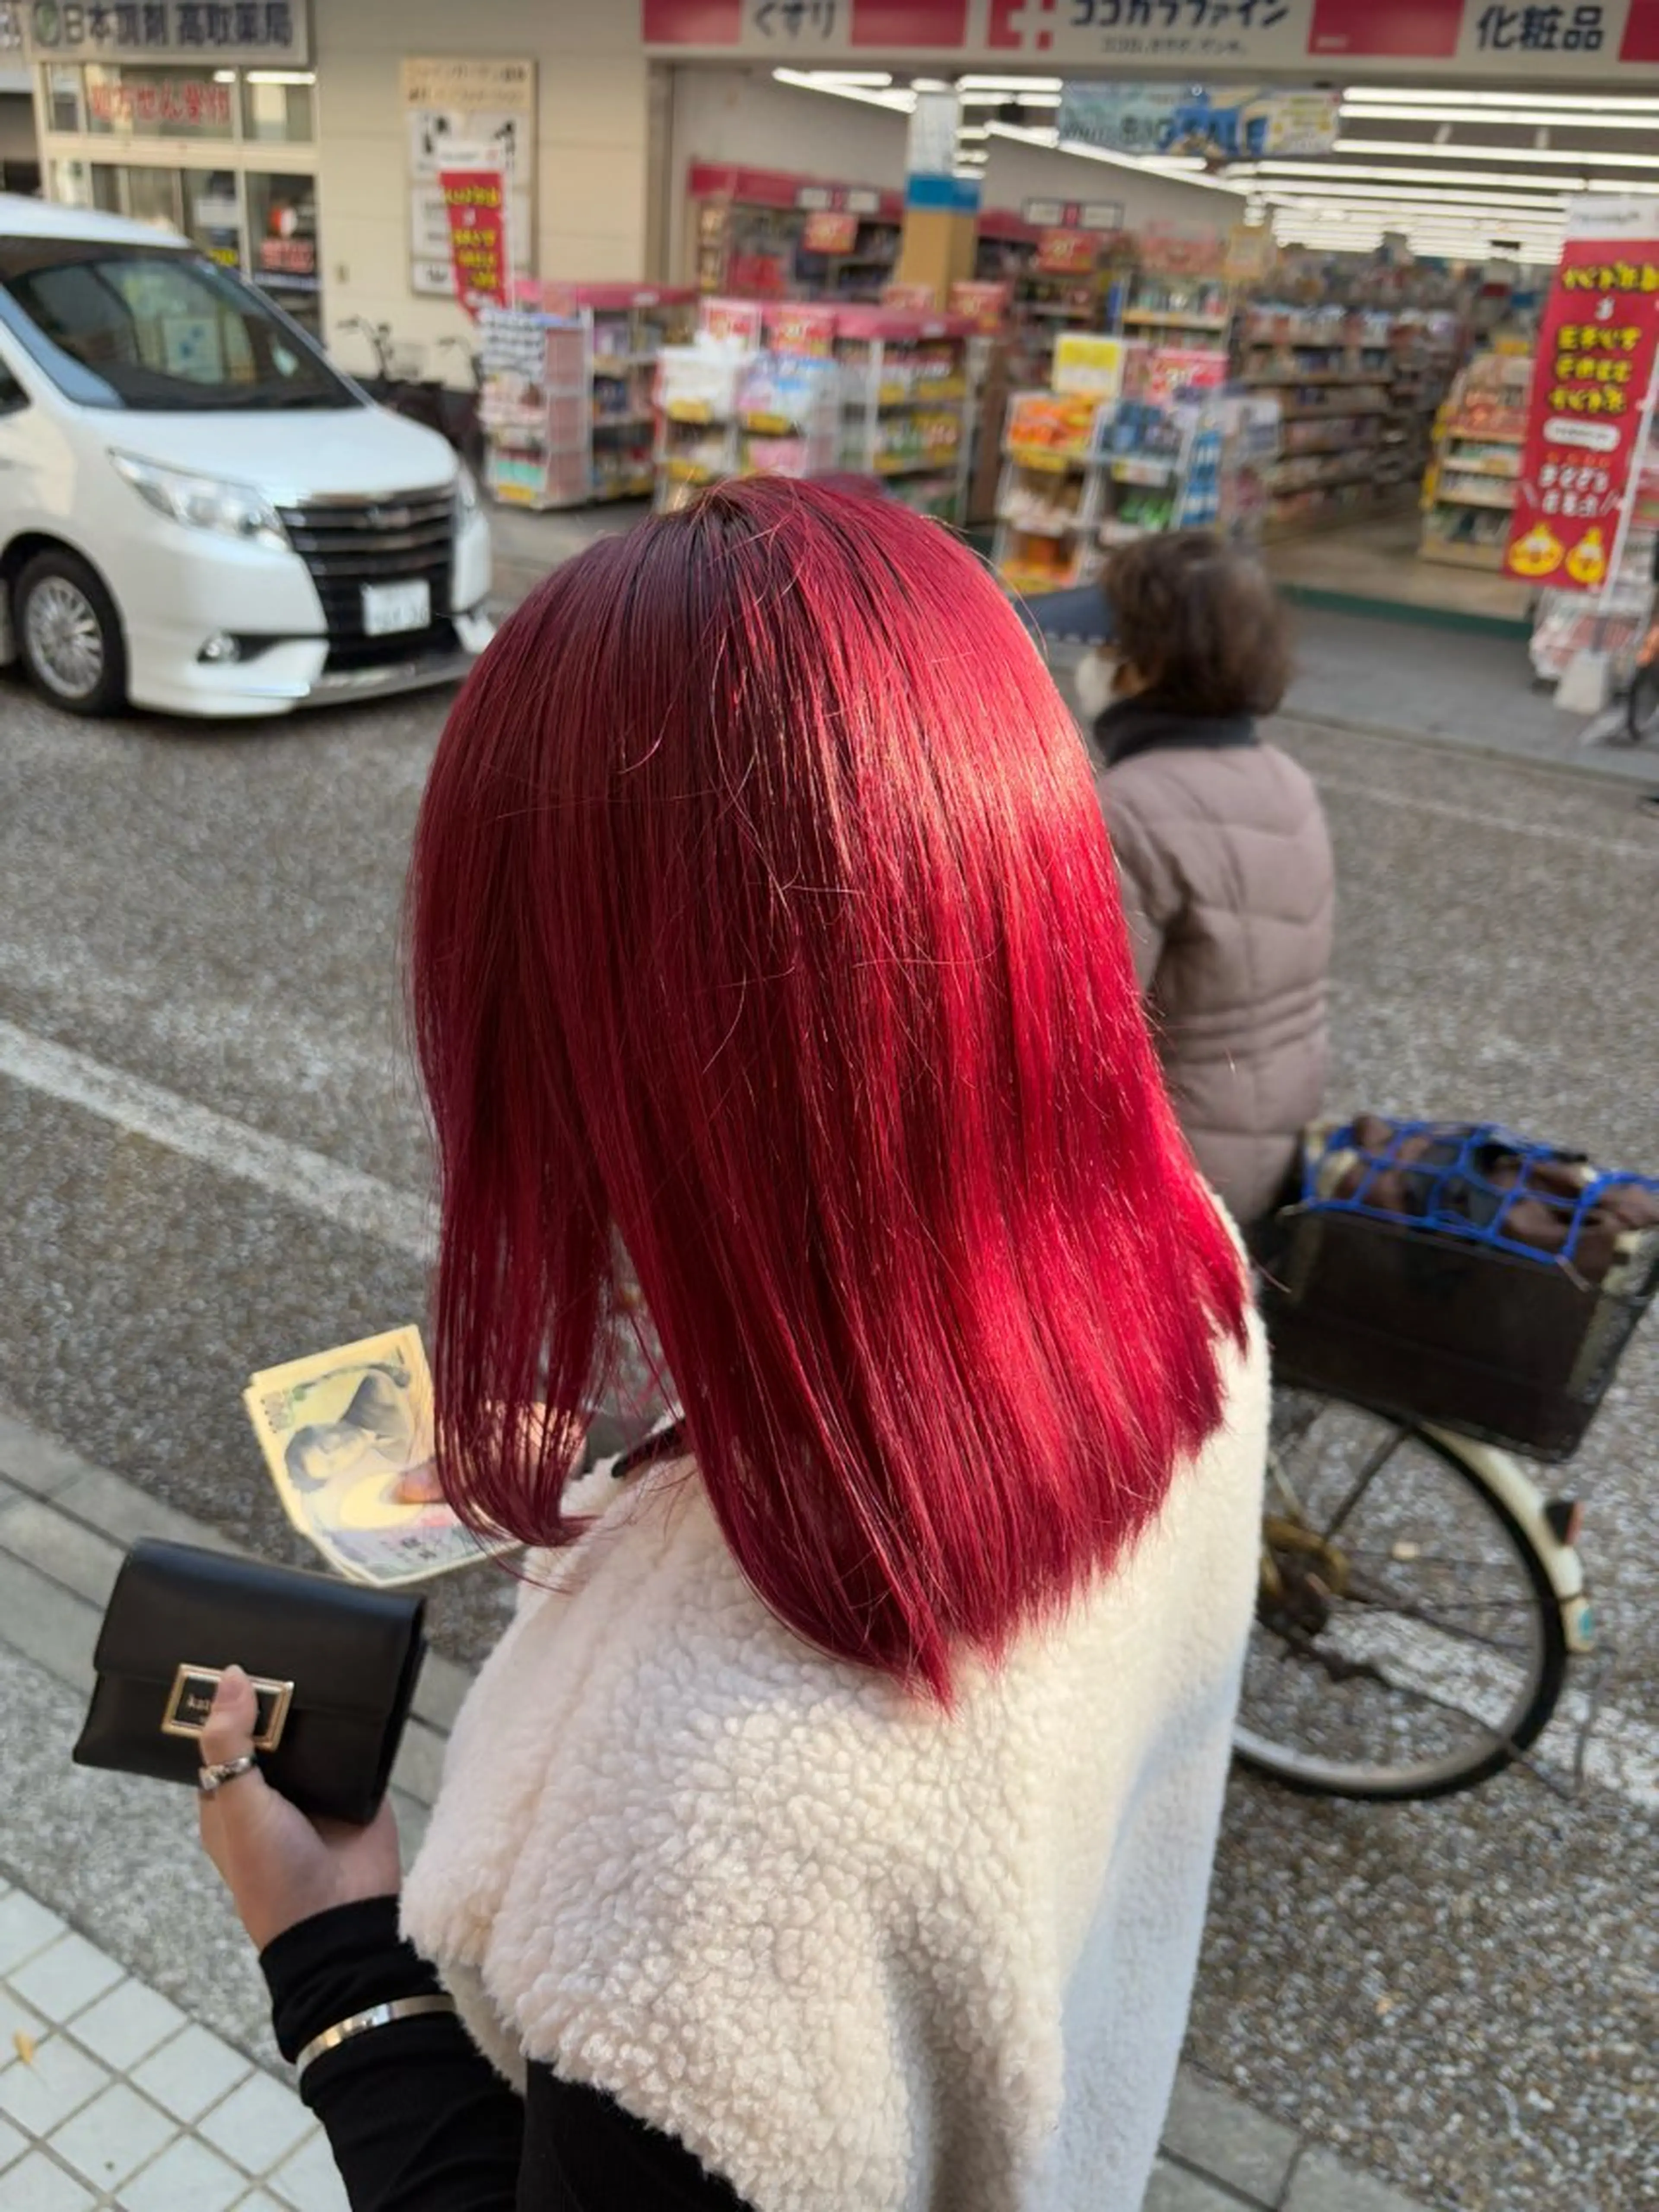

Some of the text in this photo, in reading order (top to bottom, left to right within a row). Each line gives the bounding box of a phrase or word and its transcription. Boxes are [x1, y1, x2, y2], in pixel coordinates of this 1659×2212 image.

[753, 0, 836, 39] くすり
[1477, 5, 1604, 51] 化粧品
